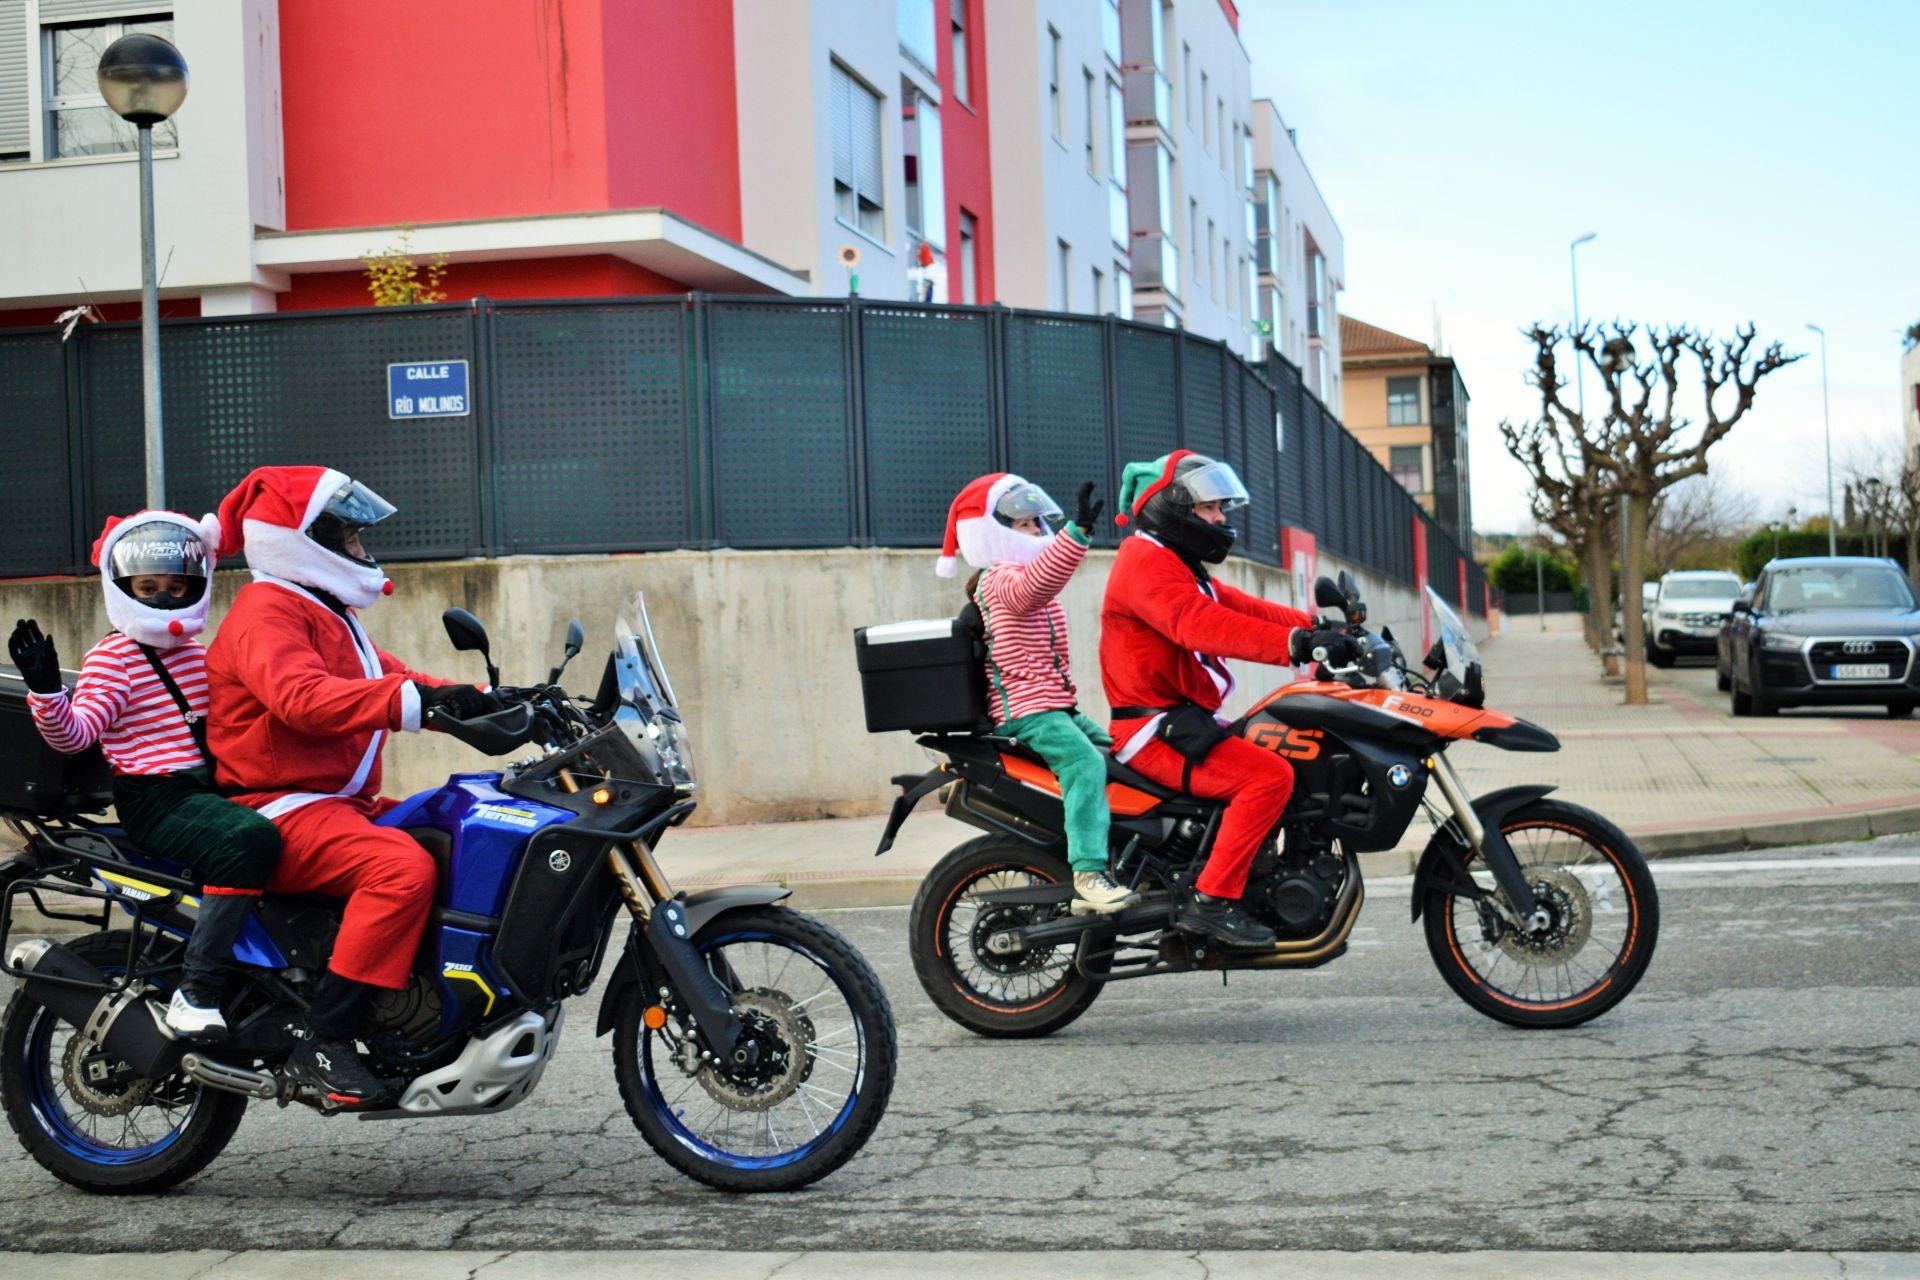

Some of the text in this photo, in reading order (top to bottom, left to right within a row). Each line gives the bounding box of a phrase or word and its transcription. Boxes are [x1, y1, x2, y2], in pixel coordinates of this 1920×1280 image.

[406, 366, 450, 380] CALLE
[395, 395, 464, 414] RÍO MOLINOS
[148, 548, 177, 557] HJC
[1382, 695, 1434, 717] F 800
[1244, 722, 1324, 761] GS
[121, 885, 151, 902] YAMAHA
[443, 961, 473, 972] 700
